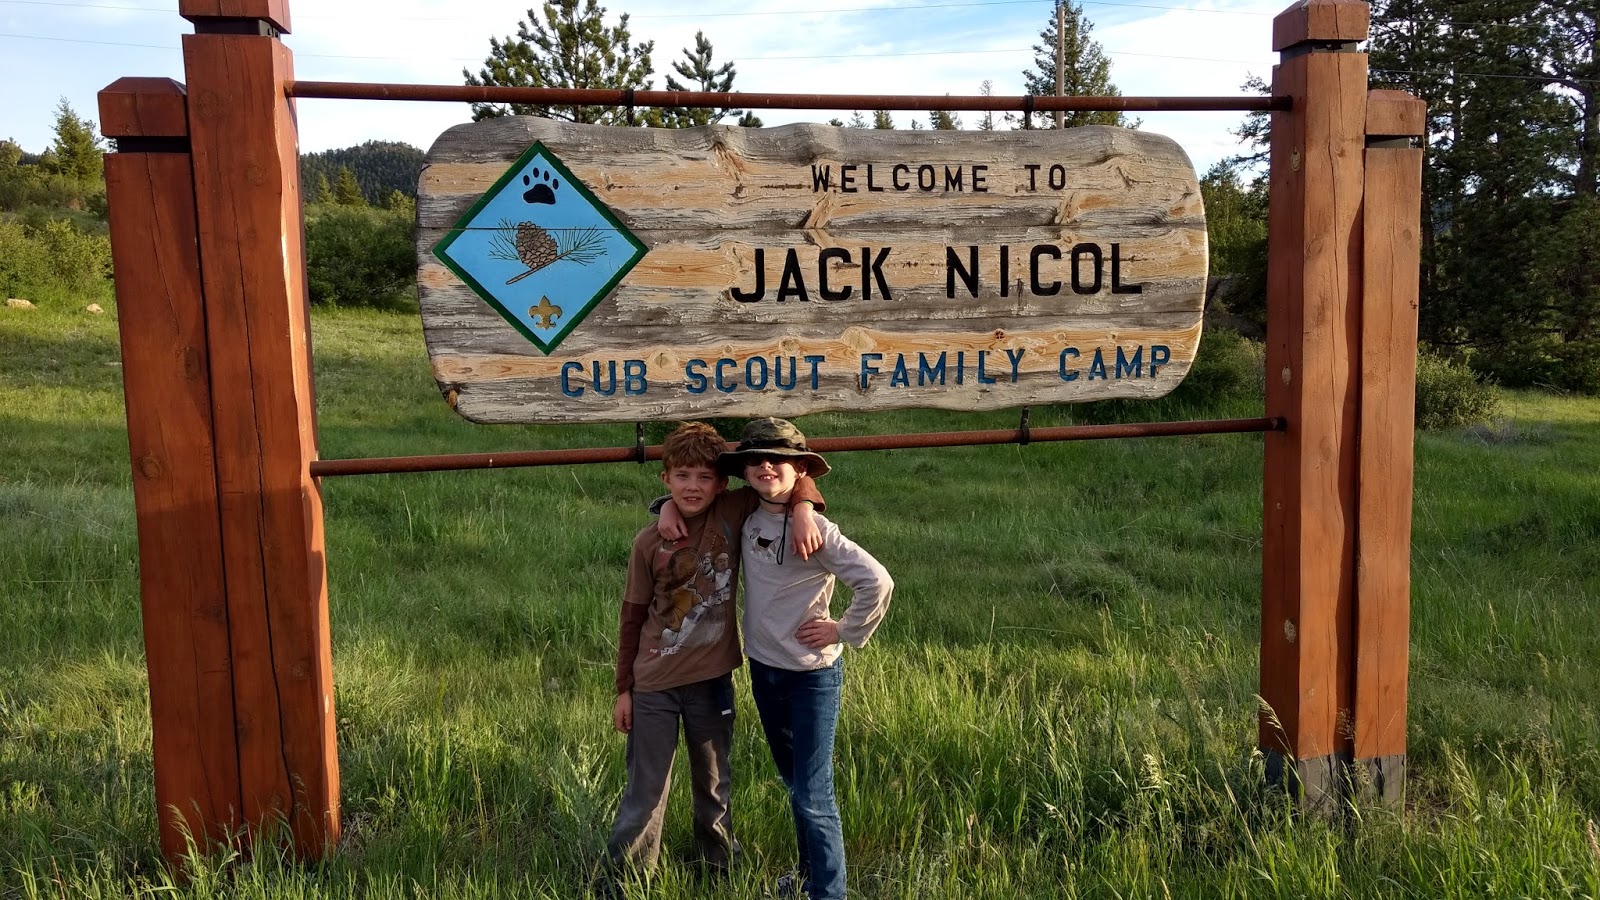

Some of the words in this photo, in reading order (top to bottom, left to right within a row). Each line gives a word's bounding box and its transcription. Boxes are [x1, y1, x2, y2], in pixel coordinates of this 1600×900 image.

[811, 163, 989, 193] WELCOME
[1025, 164, 1067, 191] TO
[731, 246, 893, 302] JACK
[946, 242, 1142, 299] NICOL
[561, 359, 648, 397] CUB
[685, 355, 825, 394] SCOUT
[861, 348, 1026, 389] FAMILY
[1059, 345, 1171, 381] CAMP
